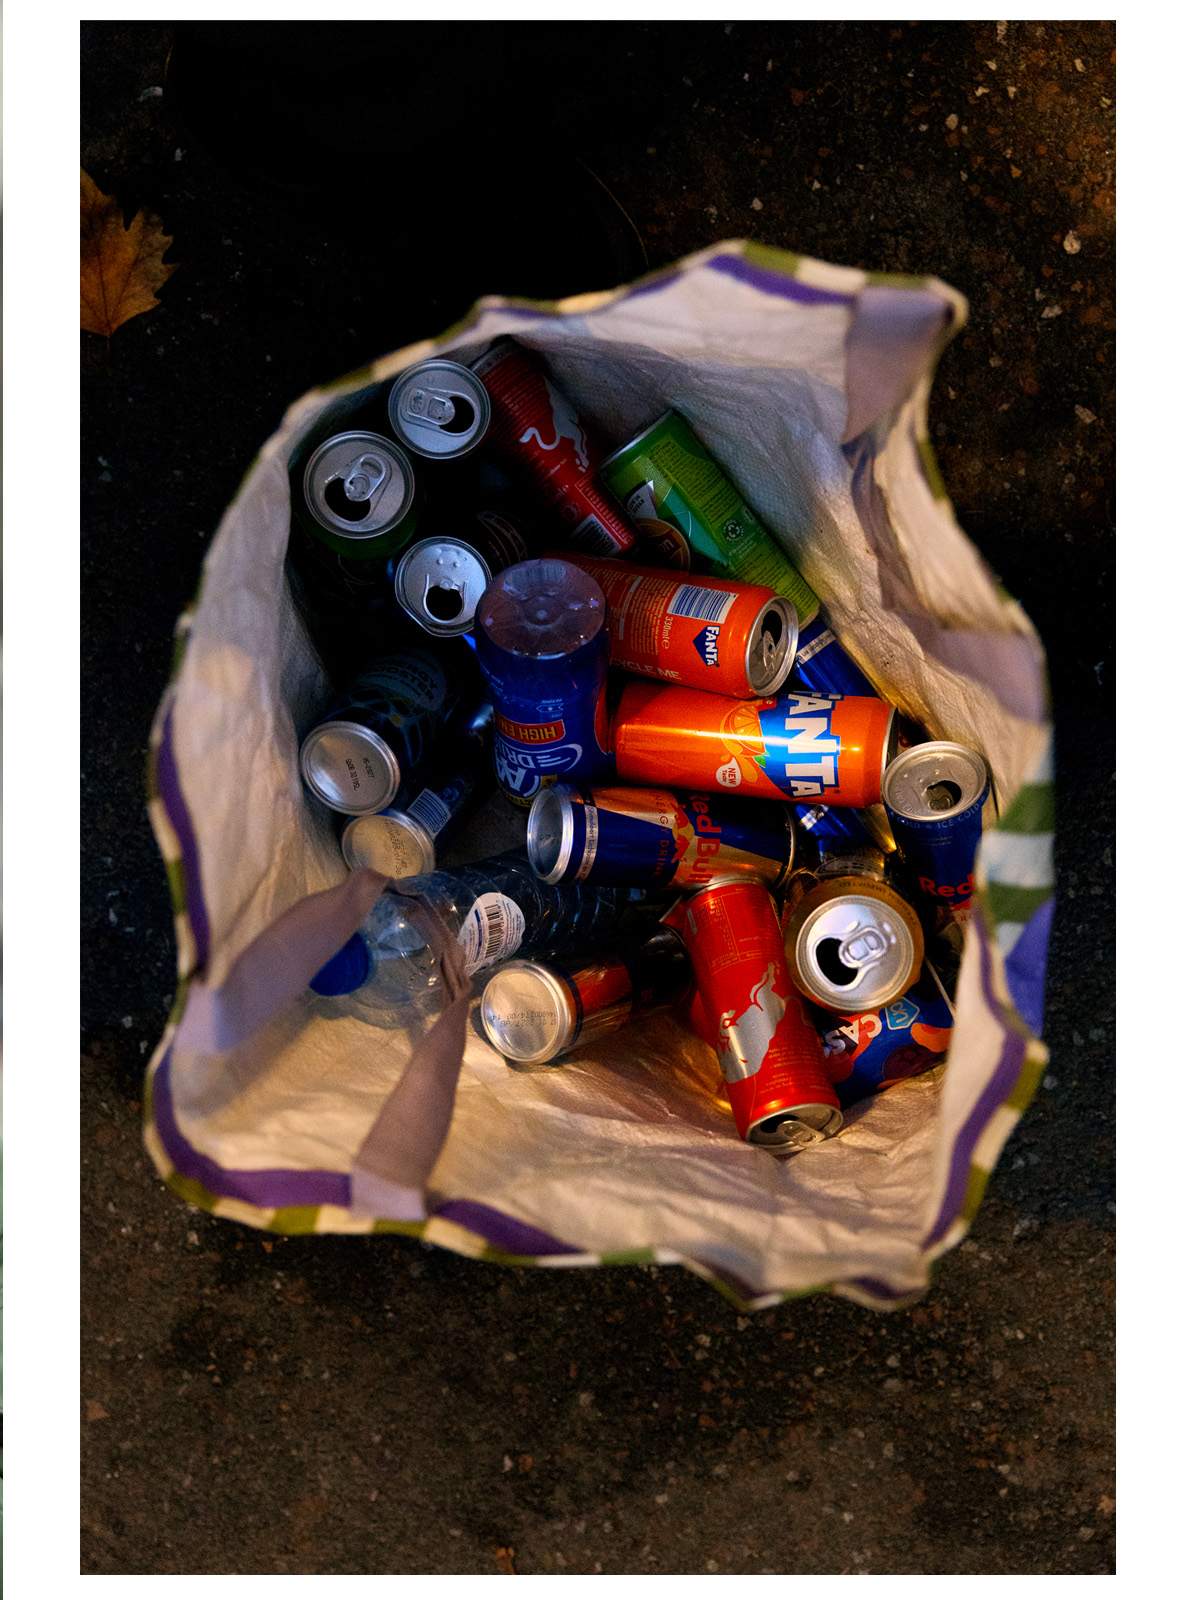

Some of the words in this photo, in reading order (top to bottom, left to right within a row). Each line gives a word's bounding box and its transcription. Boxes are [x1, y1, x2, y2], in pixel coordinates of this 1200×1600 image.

[704, 625, 721, 666] FANTA
[657, 667, 682, 681] ME
[518, 725, 555, 740] HIGH
[785, 691, 842, 797] ANTA
[728, 767, 737, 787] NEW
[689, 793, 721, 832] Red
[937, 819, 953, 828] ICE
[957, 802, 979, 821] COLD
[652, 840, 668, 876] DRINK
[684, 837, 719, 883] Bull
[918, 873, 974, 897] Red
